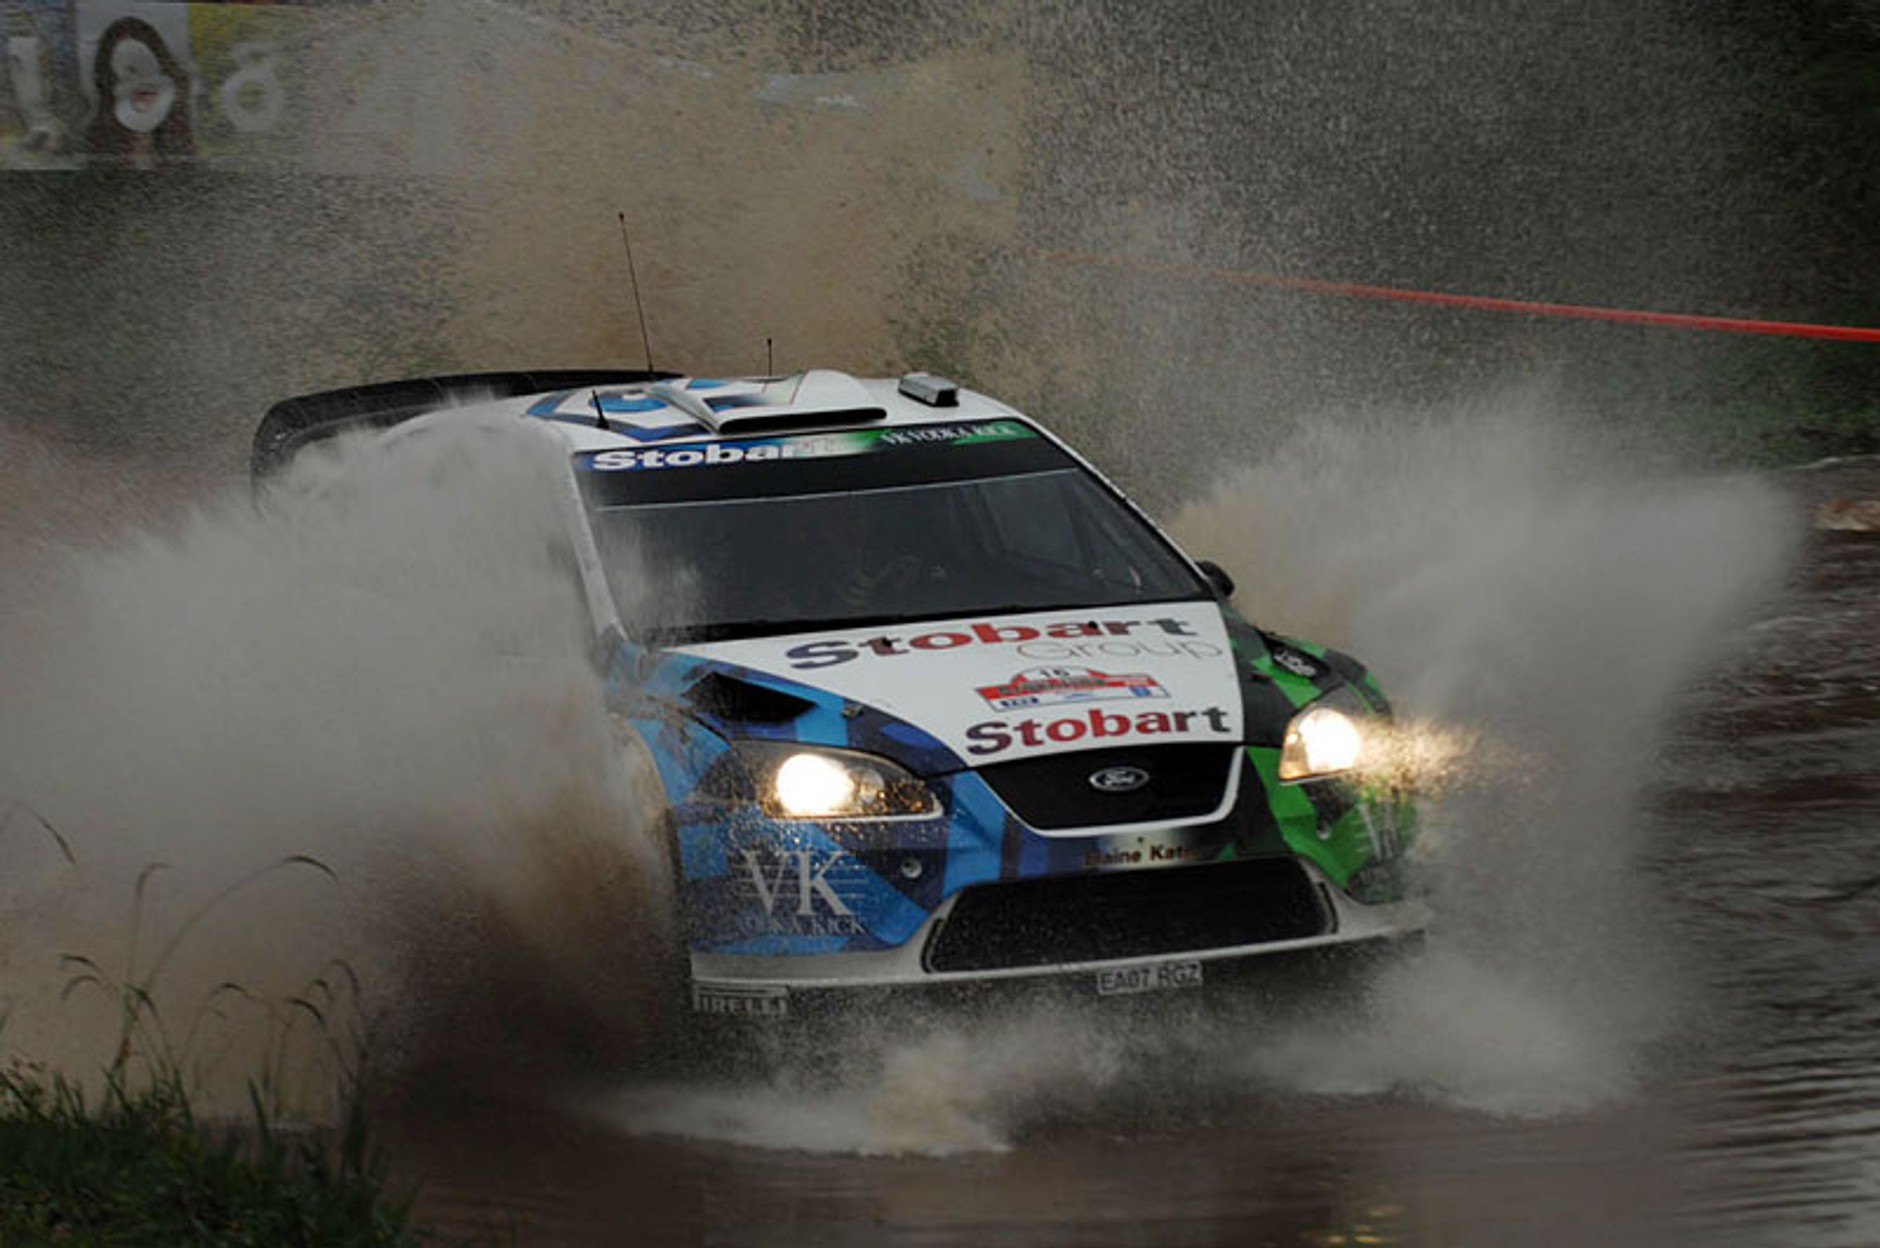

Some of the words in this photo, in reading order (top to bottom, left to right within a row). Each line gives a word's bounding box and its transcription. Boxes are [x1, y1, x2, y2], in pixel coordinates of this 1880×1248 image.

[785, 617, 1198, 670] Stobart
[1016, 638, 1224, 661] Group
[965, 706, 1231, 755] Stobart
[741, 850, 856, 917] VK
